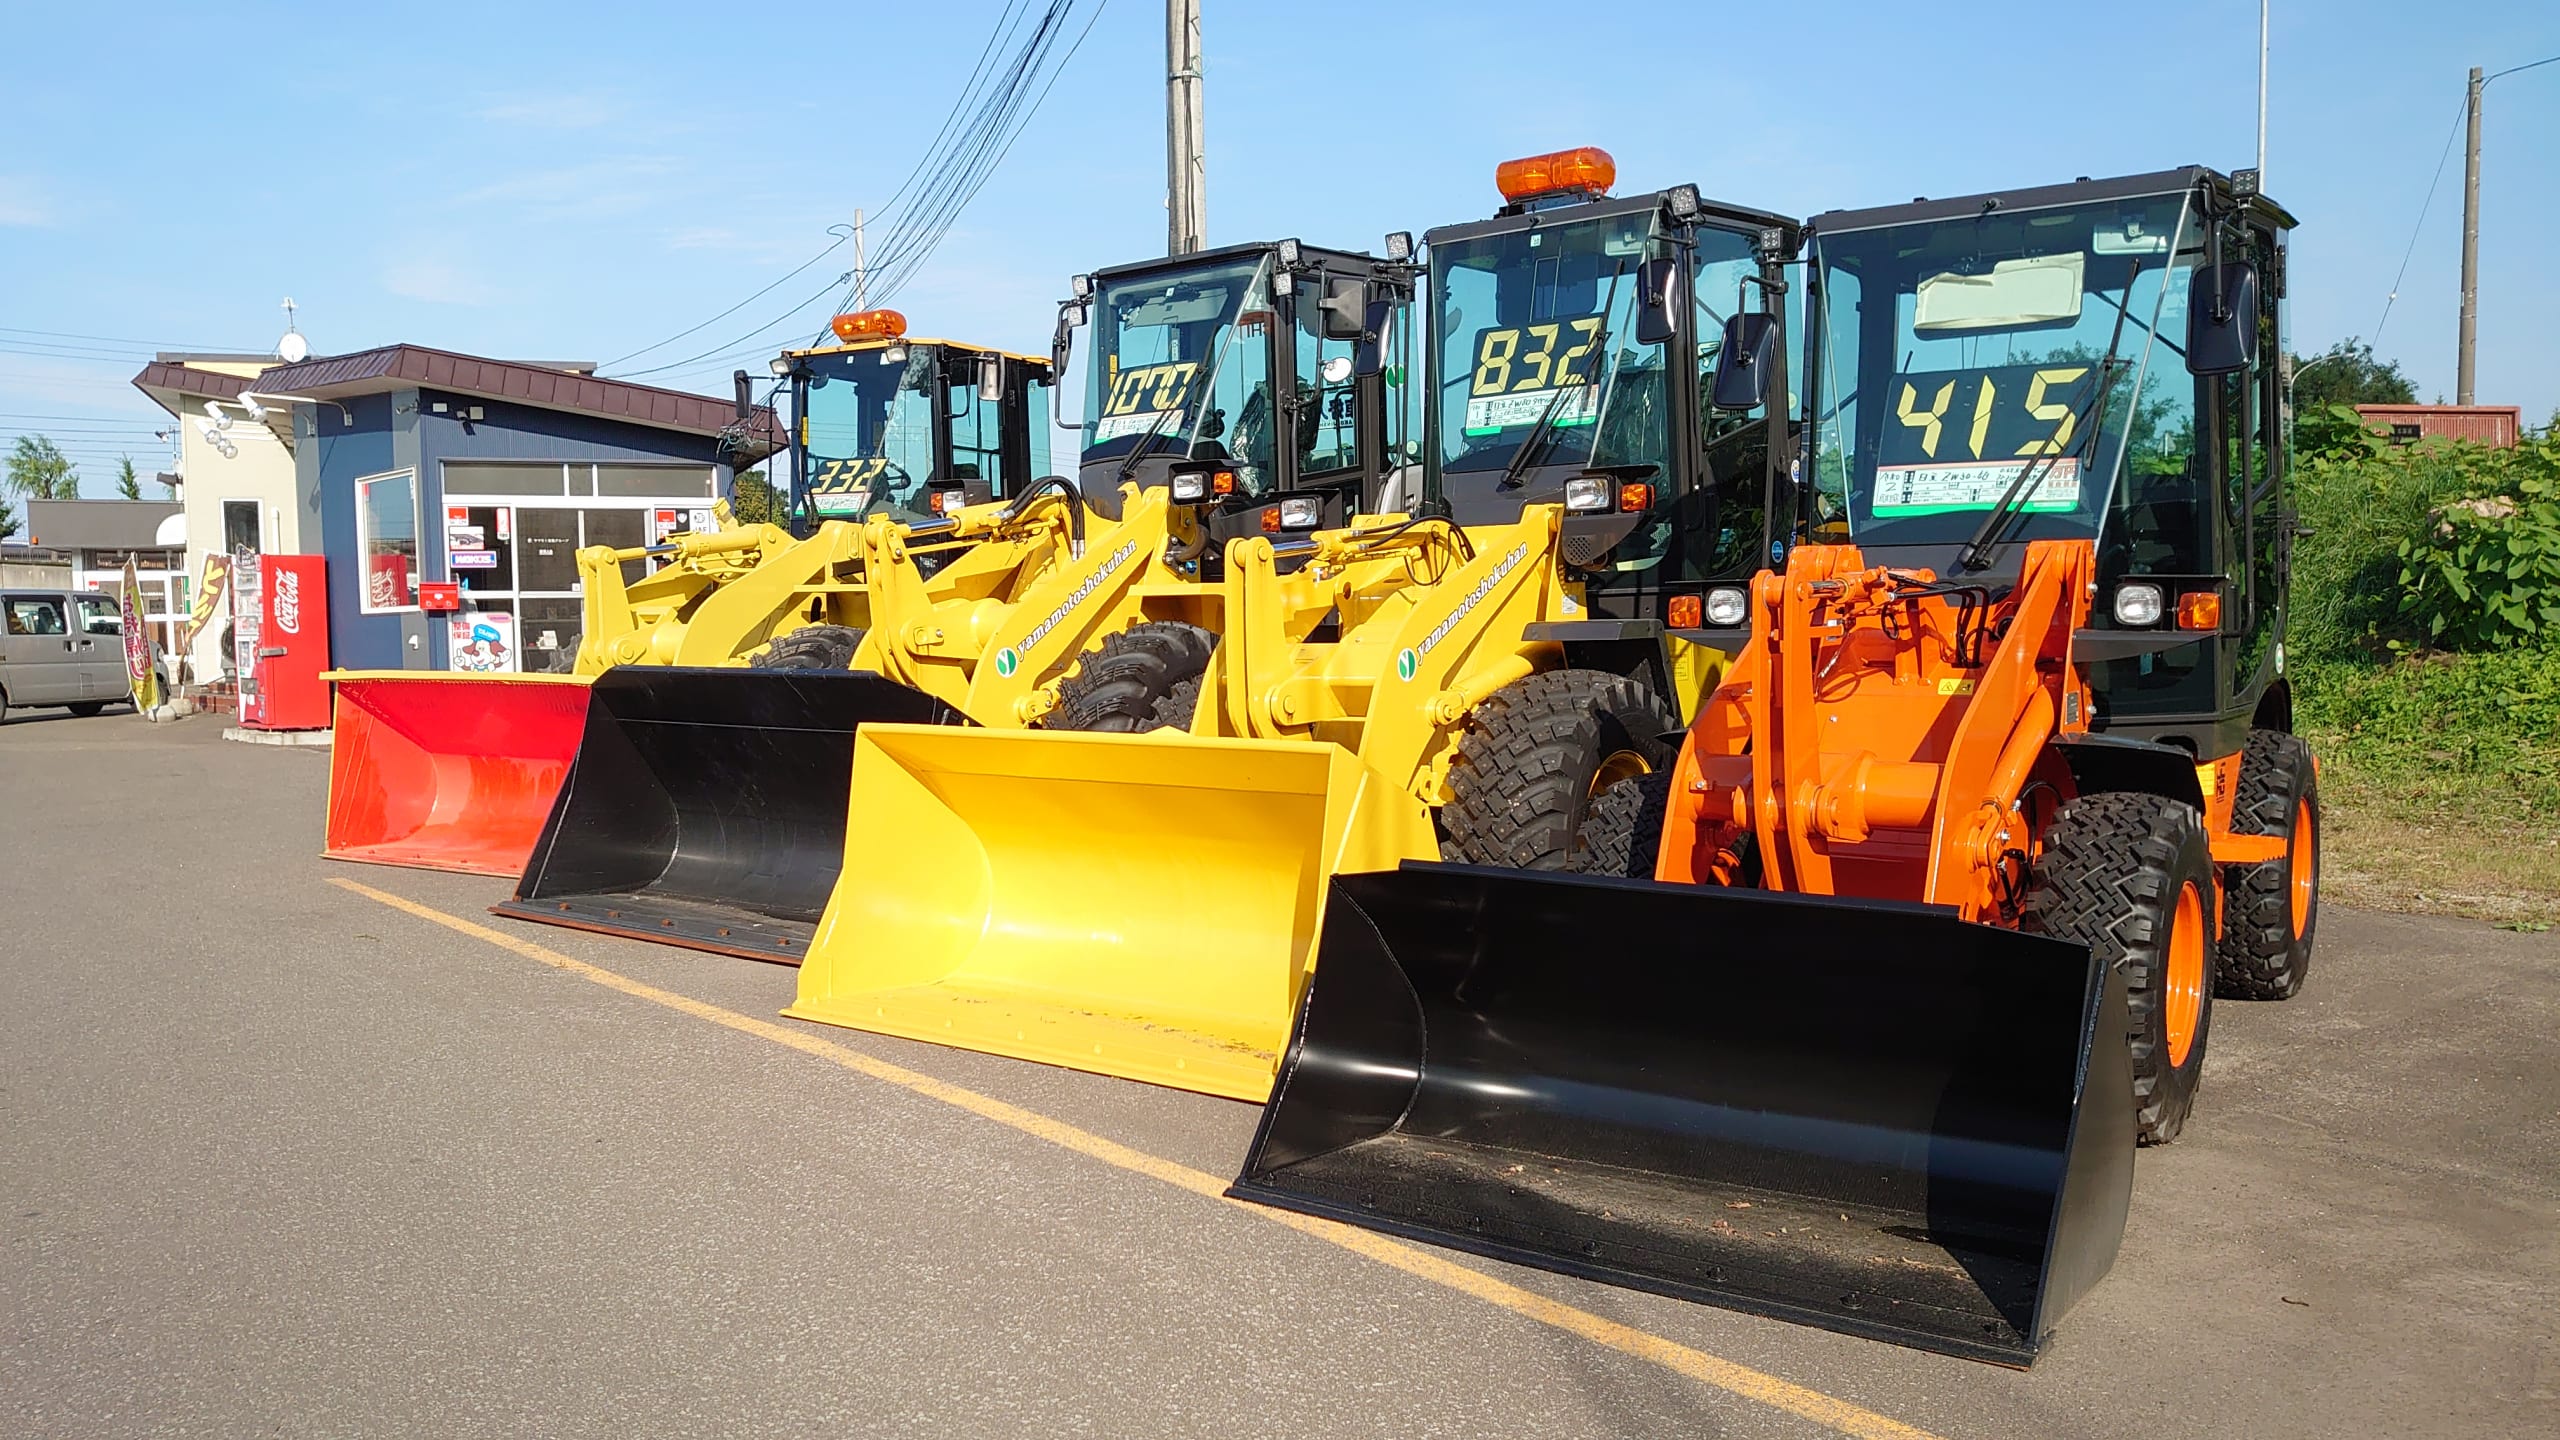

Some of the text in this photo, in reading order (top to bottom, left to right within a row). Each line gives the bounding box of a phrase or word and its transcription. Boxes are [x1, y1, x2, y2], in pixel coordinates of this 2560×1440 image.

[1103, 362, 1199, 417] 1070
[1473, 317, 1602, 396] 832
[1896, 367, 2089, 460] 415
[810, 458, 888, 494] 332
[276, 567, 299, 634] Coca-Cola
[1017, 539, 1137, 663] yamamotoshokuhan
[1417, 541, 1529, 667] yamamotoshokuhan
